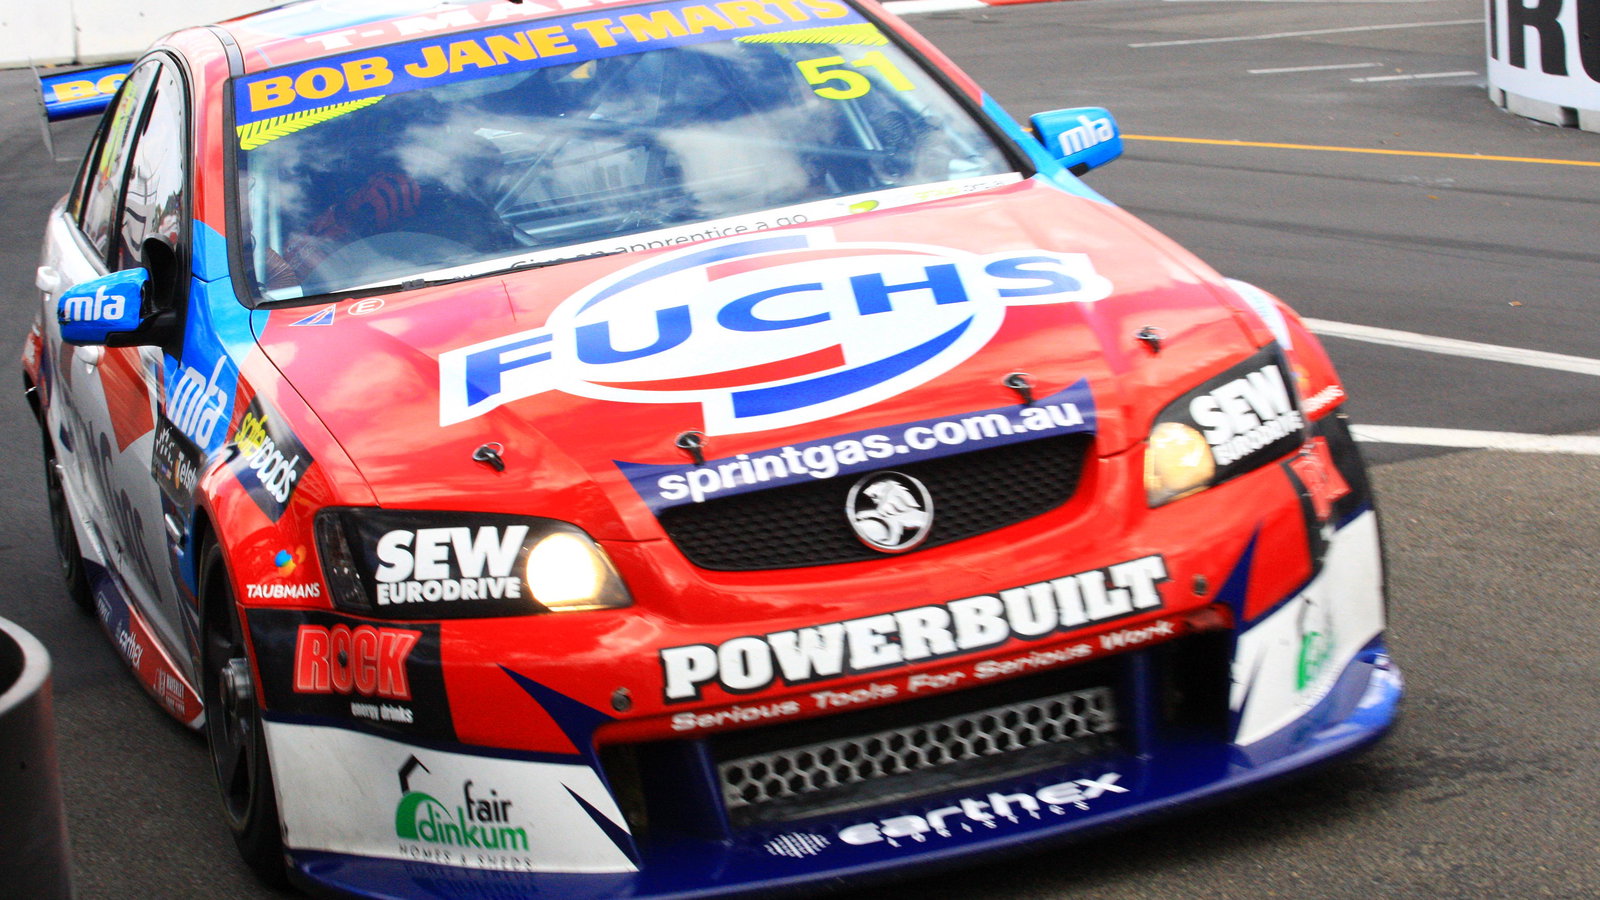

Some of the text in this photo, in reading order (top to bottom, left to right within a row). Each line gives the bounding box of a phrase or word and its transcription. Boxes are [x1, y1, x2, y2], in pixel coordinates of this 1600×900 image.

[247, 0, 850, 112] BOB JANE T-MARTS
[796, 51, 916, 100] 51
[1058, 115, 1115, 157] mfa
[64, 284, 126, 322] mfa
[466, 256, 1083, 408] FUCHS
[168, 354, 228, 449] mfa
[1189, 364, 1295, 445] SEW
[657, 398, 1083, 502] sprintgas.com.au
[246, 582, 321, 599] TAUBMANS
[375, 525, 530, 583] SEW
[376, 576, 522, 606] EURODRIVE
[293, 622, 423, 701] ROCK
[662, 555, 1168, 700] POWERBUILT
[671, 619, 1175, 733] Serious Tools For Serious Work
[418, 802, 530, 851] dinkum
[464, 779, 513, 823] fair
[837, 771, 1131, 848] earthex
